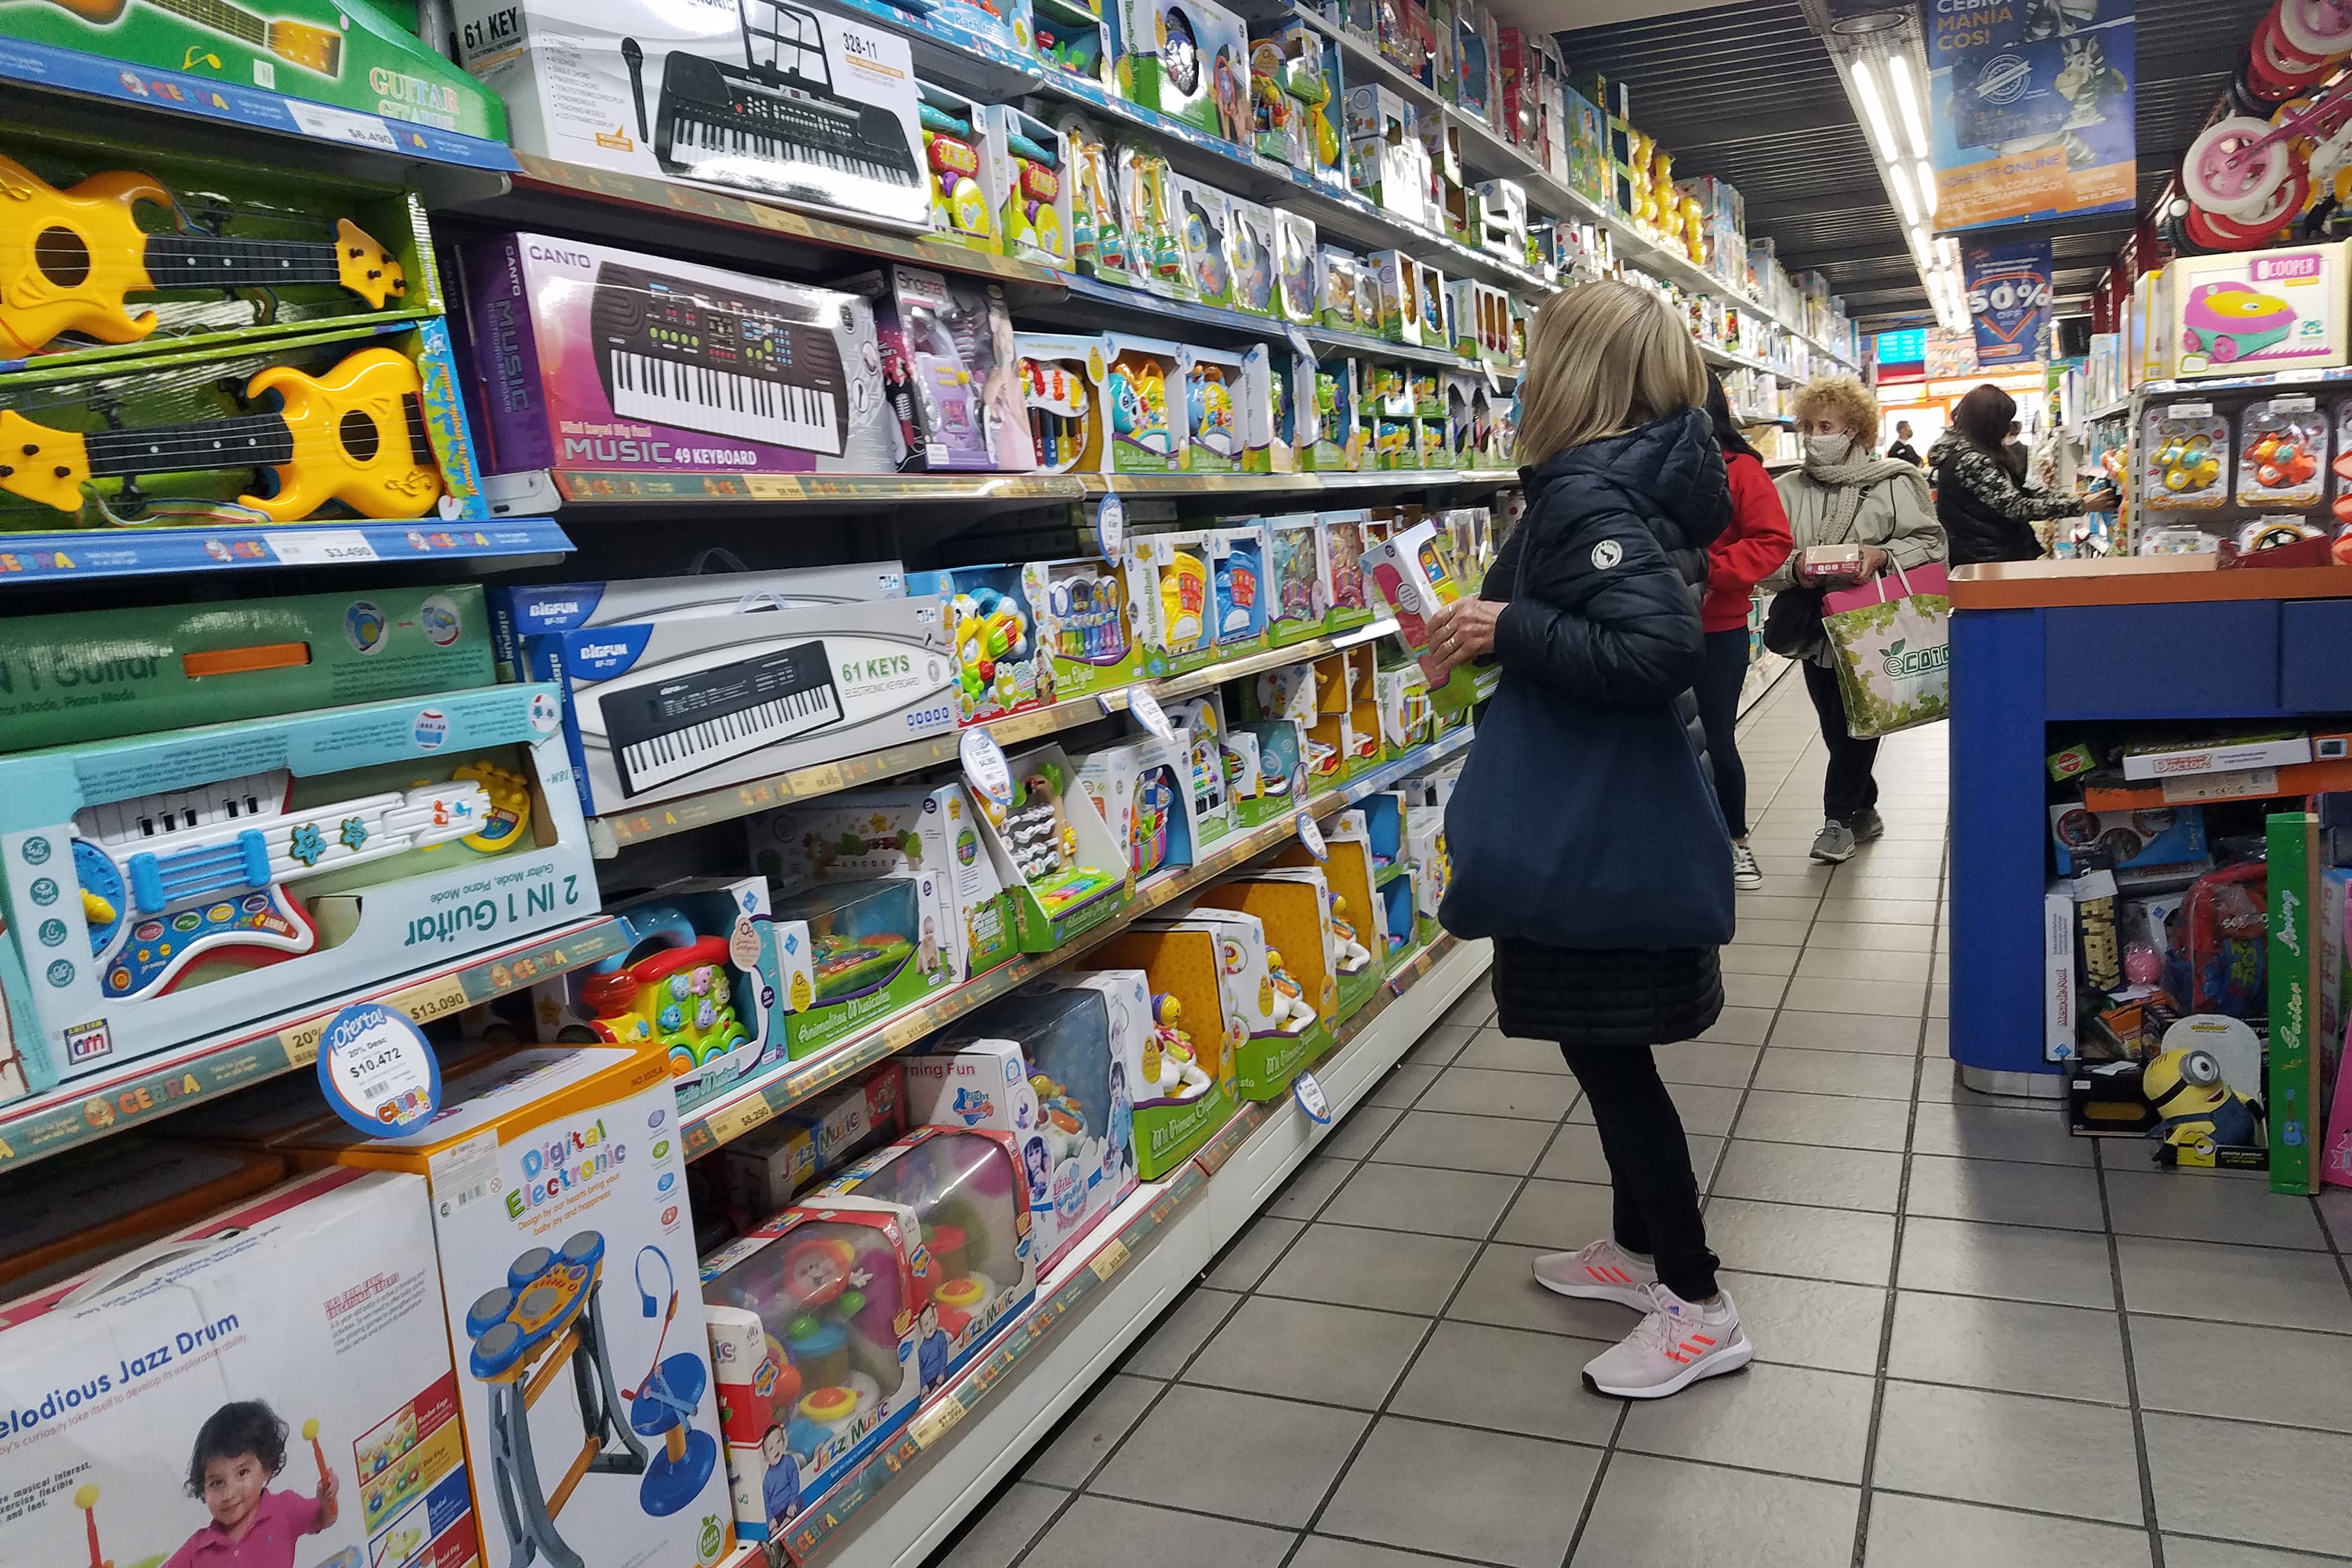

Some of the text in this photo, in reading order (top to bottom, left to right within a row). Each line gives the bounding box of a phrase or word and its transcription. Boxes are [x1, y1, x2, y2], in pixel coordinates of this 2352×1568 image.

[1936, 0, 2013, 13] CEB
[464, 6, 518, 49] 61 KEY
[1937, 30, 1990, 50] COS!
[843, 32, 877, 60] 328-11
[369, 67, 461, 114] GUITAR
[348, 129, 392, 145] $6.490
[2004, 154, 2060, 176] ONLINE
[505, 245, 521, 296] CANTO
[529, 245, 591, 269] CANTO
[2269, 257, 2314, 277] COOPER
[1969, 282, 2051, 314] 50%
[495, 299, 528, 412] MUSIC
[564, 437, 757, 466] MUSIC 49 KEYBOARD
[326, 545, 371, 559] $3.490
[529, 601, 579, 617] BIGFUN
[580, 644, 629, 659] BIGFUN
[842, 654, 910, 684] 61 KEYS
[844, 677, 920, 698] ELECTRONIC KEYBOARD
[430, 862, 554, 905] Guitar Mode, Piano Mode
[404, 874, 579, 947] 2 IN 1 Guitar
[411, 993, 464, 1020] $13.090
[798, 1009, 847, 1043] Animalitos
[847, 986, 891, 1018] Musicales
[2281, 982, 2303, 1049] Guitar
[292, 1027, 323, 1048] 20%
[348, 1036, 387, 1058] 20% Desc
[350, 1047, 402, 1079] $10.472
[947, 1063, 975, 1076] Fun
[741, 1106, 769, 1126] $8.290
[817, 1110, 860, 1156] Music
[521, 1118, 607, 1181] Digital
[505, 1143, 626, 1221] Electronic
[518, 1214, 542, 1231] Design
[553, 1202, 564, 1212] our
[589, 1180, 608, 1196] bring
[608, 1173, 620, 1187] your
[533, 1222, 550, 1236] baby
[564, 1207, 576, 1219] and
[578, 1190, 611, 1213] happiness
[958, 1290, 1014, 1348] Jazz Music
[118, 1345, 172, 1385] Jazz
[175, 1313, 240, 1356] Drum
[23, 1421, 67, 1446] curiosity
[69, 1412, 89, 1428] take
[89, 1398, 114, 1419] itself
[125, 1376, 162, 1400] develop
[173, 1348, 220, 1376] exploration
[222, 1334, 249, 1352] ability.
[812, 1436, 847, 1474] Jazz
[851, 1400, 891, 1445] Music
[13, 1461, 92, 1497] musical interest.
[38, 1477, 74, 1498] flexible
[6, 1509, 24, 1523] and
